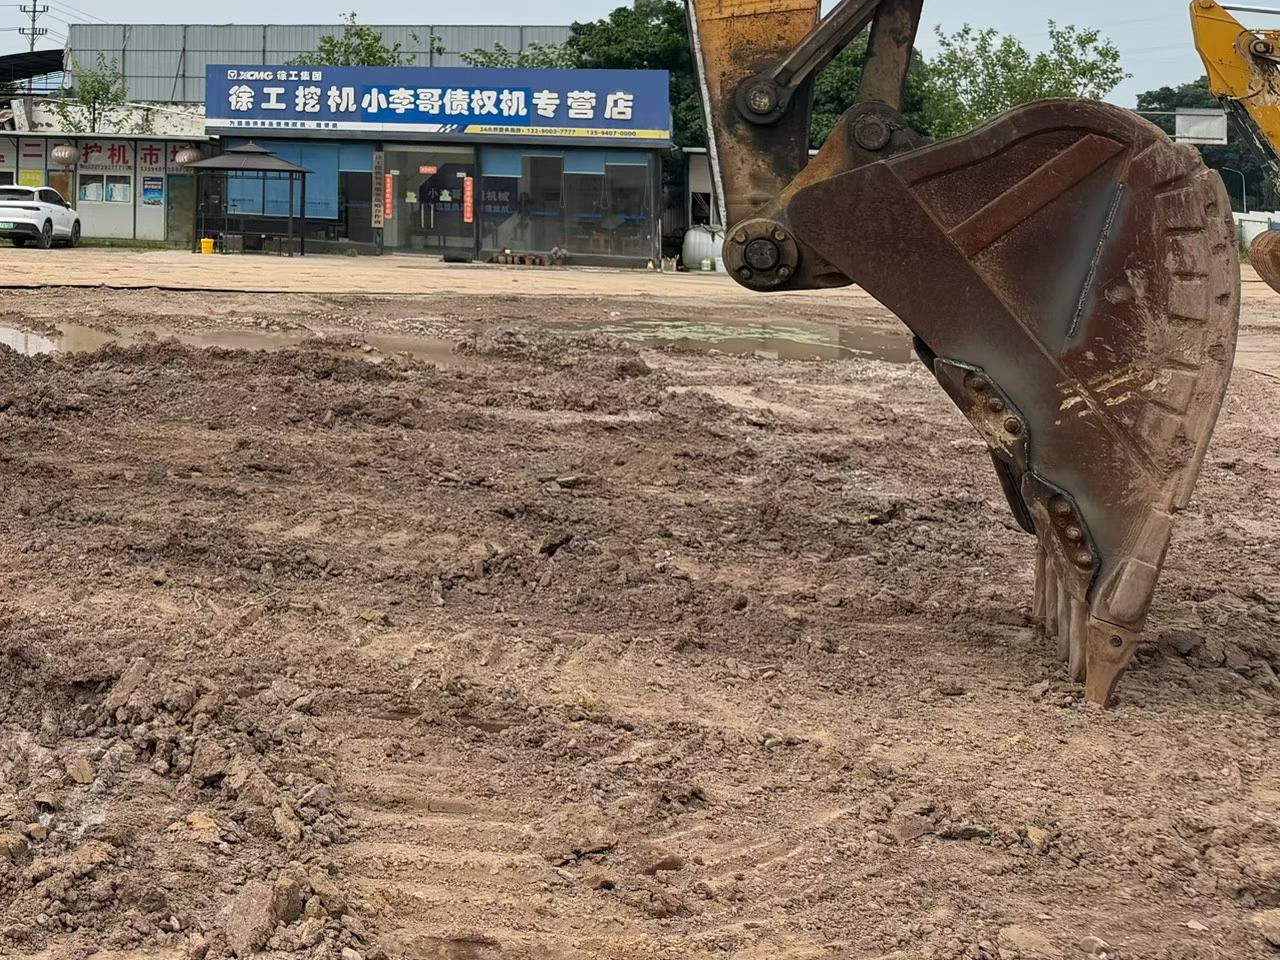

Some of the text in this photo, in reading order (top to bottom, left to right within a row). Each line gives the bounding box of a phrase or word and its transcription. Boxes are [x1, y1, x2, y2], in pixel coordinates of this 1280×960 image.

[238, 71, 322, 81] XCMG 徐工集团
[228, 85, 634, 120] 徐工挖机小李哥债权机专营店
